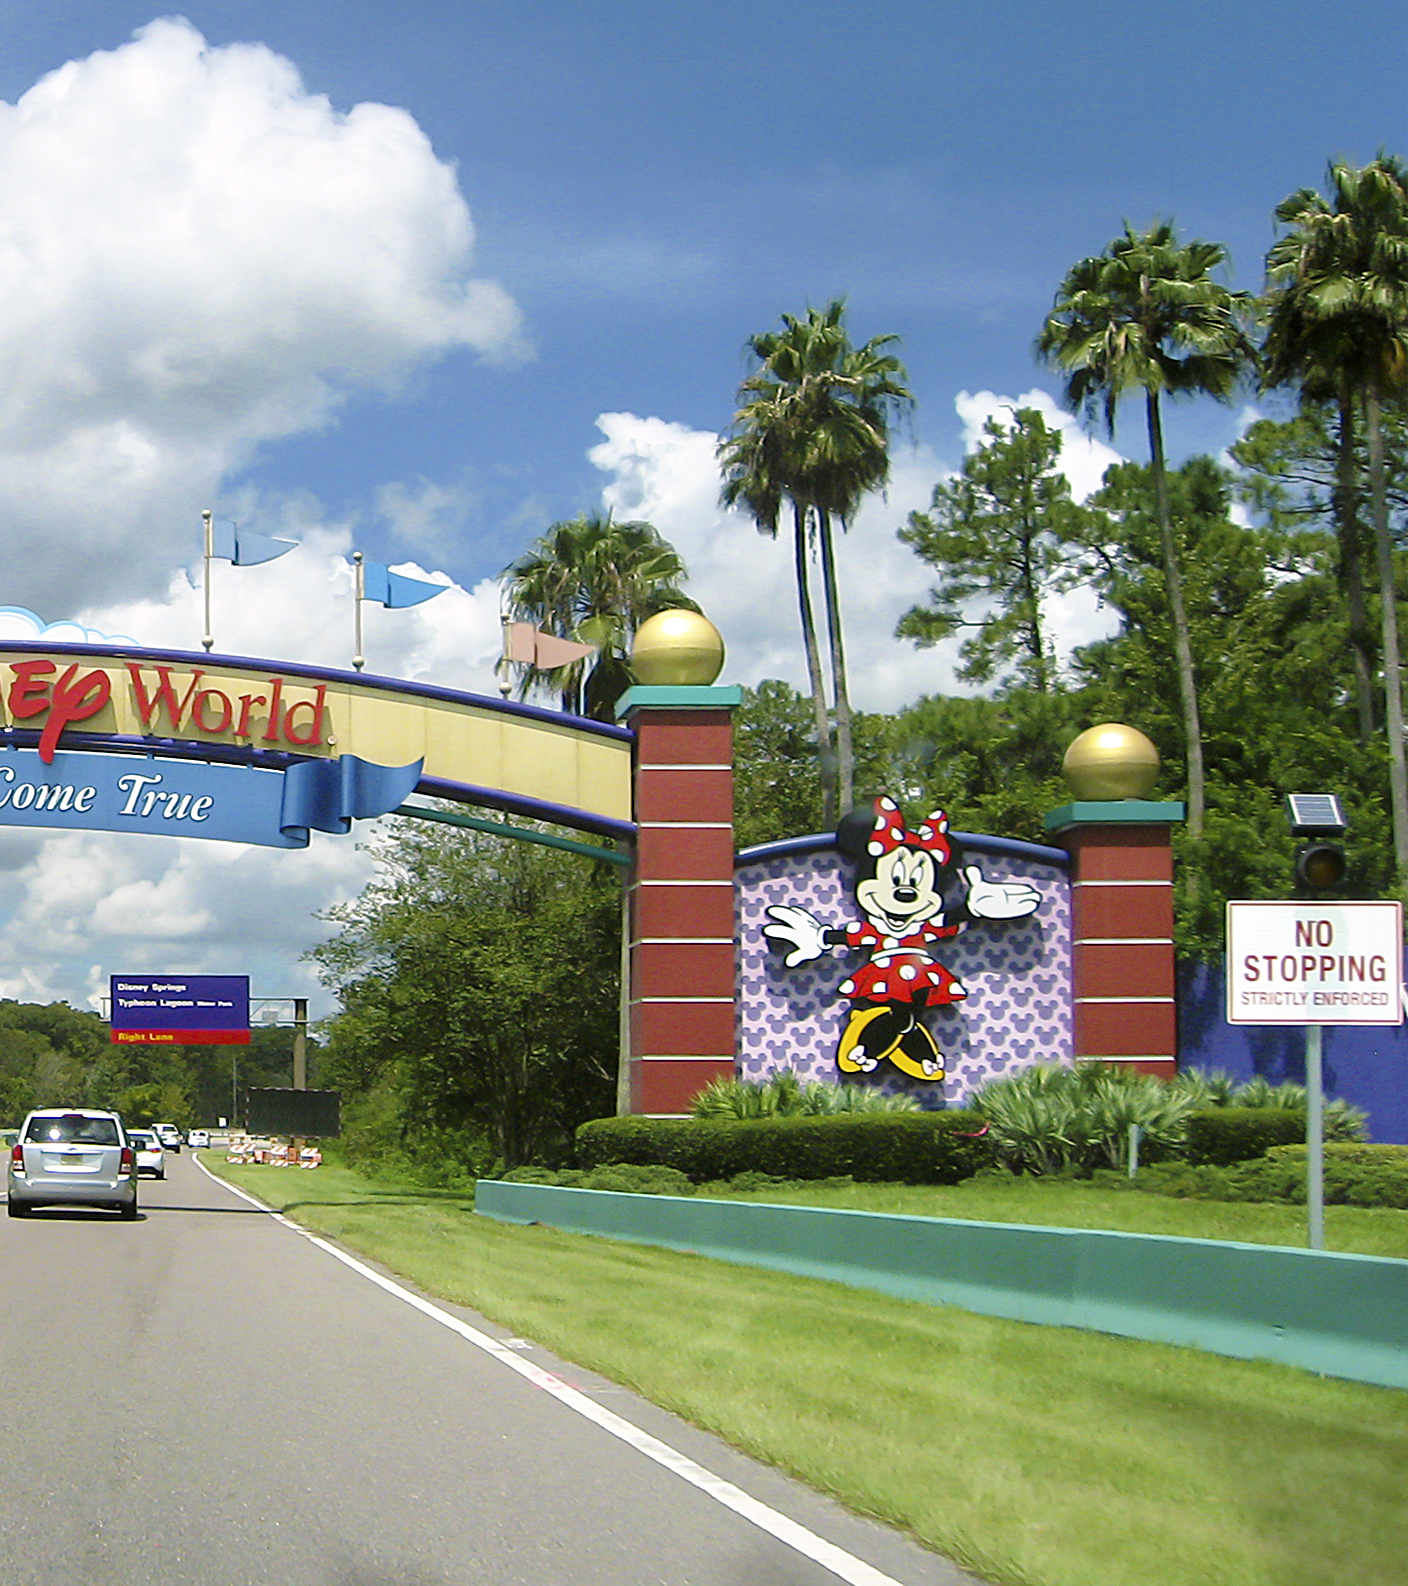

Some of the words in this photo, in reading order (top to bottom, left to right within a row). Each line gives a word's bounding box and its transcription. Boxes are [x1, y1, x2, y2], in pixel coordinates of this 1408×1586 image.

[125, 662, 328, 746] World
[117, 774, 215, 822] True
[1295, 920, 1333, 947] NO
[1244, 955, 1386, 982] STOPPING
[118, 983, 148, 992] Disney
[152, 983, 186, 992] Springs
[118, 999, 157, 1008] Typhoon
[160, 999, 193, 1008] Lagoon
[1241, 991, 1309, 1006] STRICTLY
[1313, 991, 1389, 1006] ENFORCED
[118, 1033, 145, 1042] Right
[149, 1033, 174, 1041] Lane
